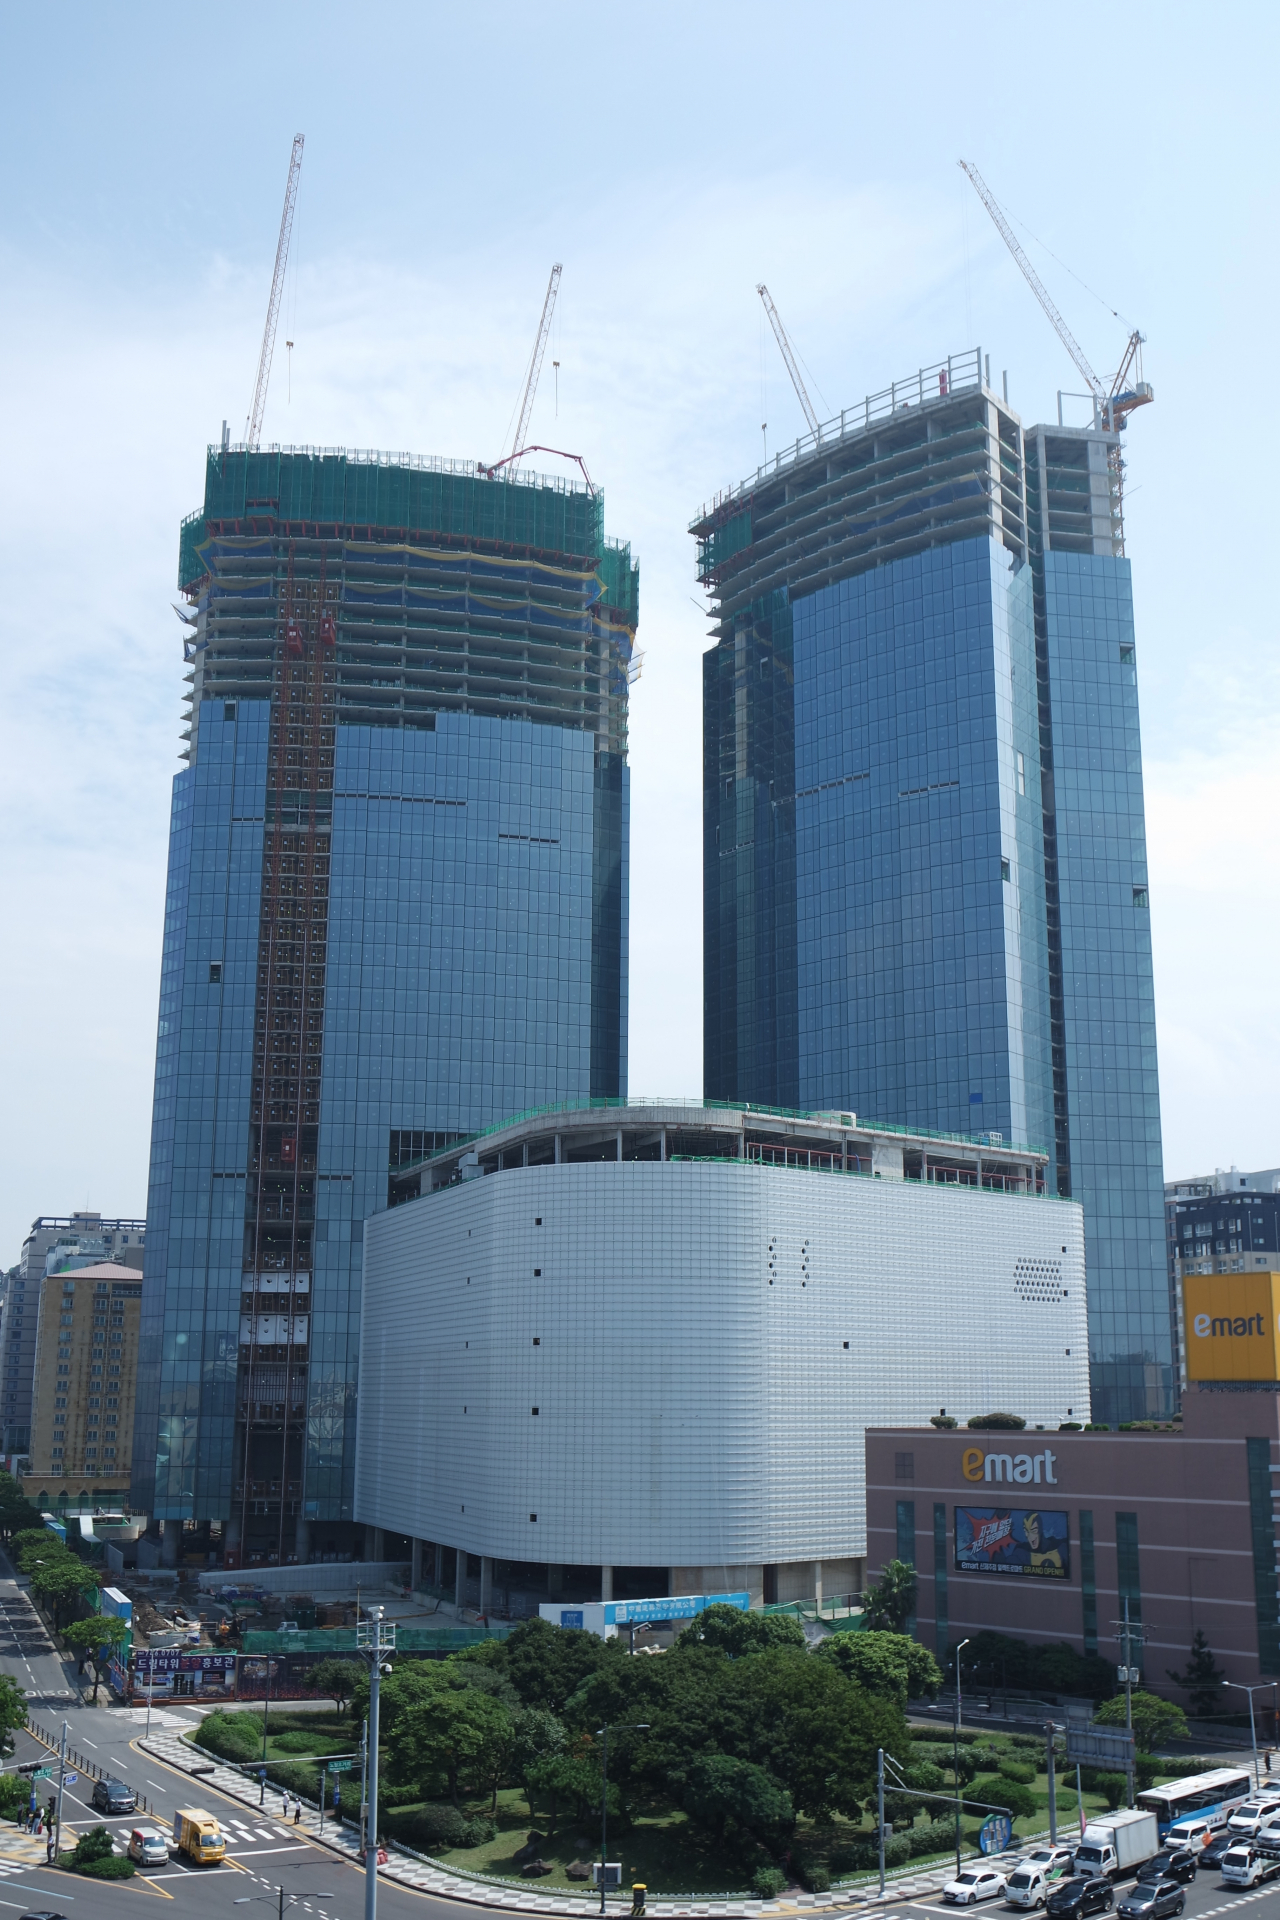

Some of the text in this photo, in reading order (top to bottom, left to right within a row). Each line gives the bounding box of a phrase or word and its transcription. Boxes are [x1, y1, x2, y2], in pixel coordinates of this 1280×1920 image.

[1194, 1313, 1265, 1338] emart
[962, 1447, 1058, 1485] emart
[961, 1562, 979, 1570] emart
[1024, 1566, 1043, 1575] GRAND
